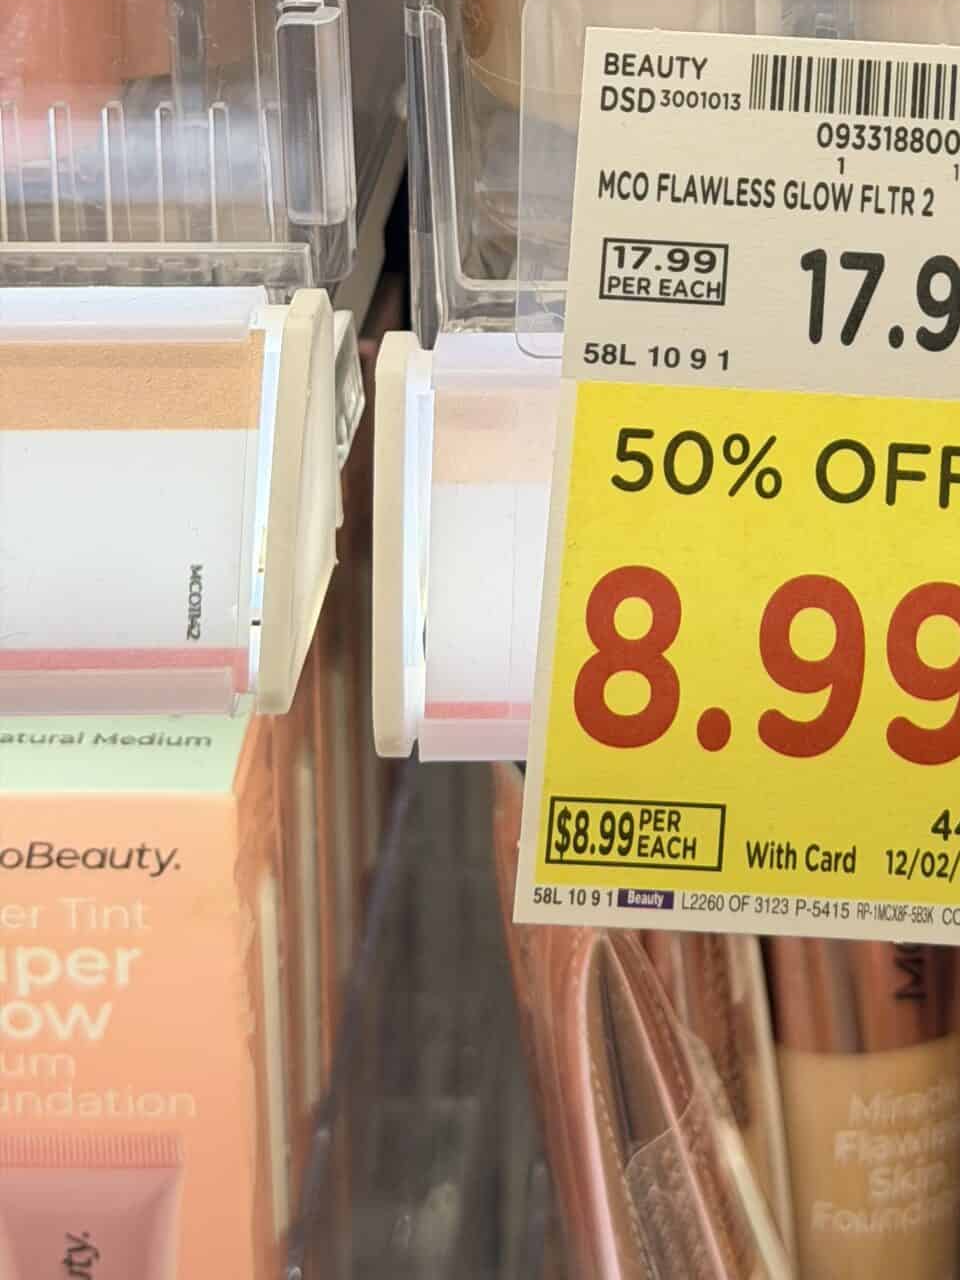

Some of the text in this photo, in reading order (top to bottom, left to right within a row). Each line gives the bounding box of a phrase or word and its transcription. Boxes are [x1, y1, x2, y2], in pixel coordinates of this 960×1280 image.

[603, 51, 709, 81] BEAUTY
[836, 156, 846, 175] 1
[597, 169, 650, 201] MCO
[655, 172, 777, 209] FLAWLESS
[782, 178, 856, 214] GLOW
[859, 182, 917, 217] FLTR
[921, 186, 936, 218] 2
[610, 243, 718, 274] 17.99
[607, 275, 722, 302] PER EACH
[582, 341, 731, 372] 58L 10 9 1
[610, 426, 783, 500] 50%
[92, 731, 213, 749] Medium
[553, 804, 636, 864] $8.99
[638, 807, 683, 834] PER
[636, 834, 698, 861] EACH
[745, 839, 858, 876] With Card
[56, 895, 152, 931] Tint
[532, 886, 564, 906] 58L
[568, 888, 587, 907] 10
[591, 889, 602, 907] 9
[605, 890, 614, 908] 1
[627, 890, 666, 910] Beauty
[681, 891, 725, 913] L2260
[728, 894, 751, 914] OF
[754, 895, 790, 915] 3123
[794, 898, 851, 920] P-5415
